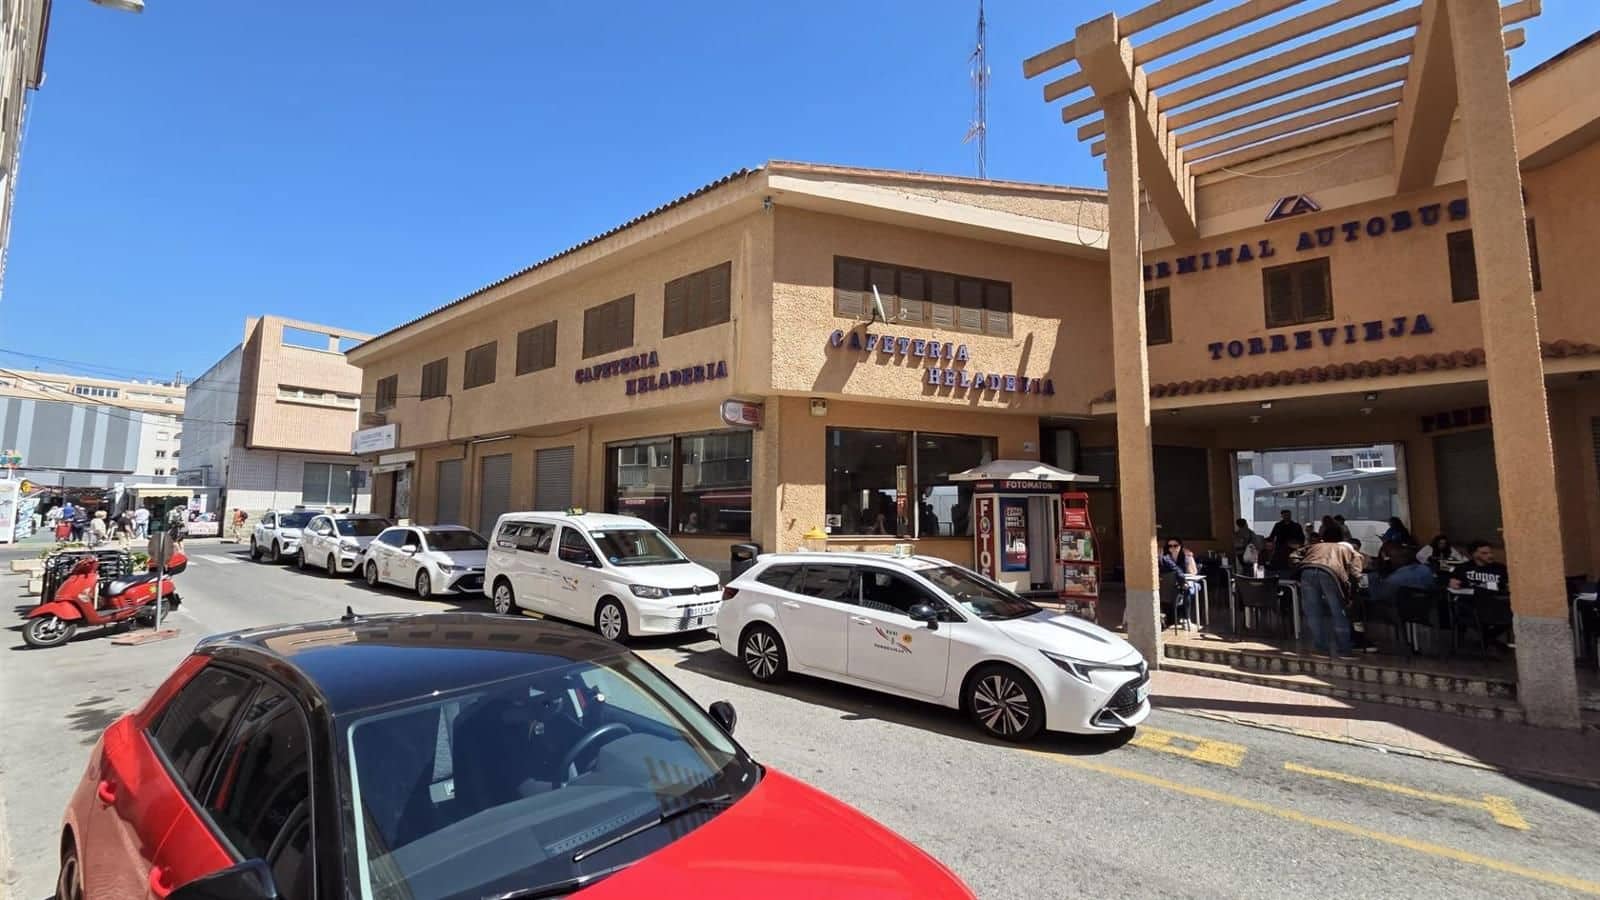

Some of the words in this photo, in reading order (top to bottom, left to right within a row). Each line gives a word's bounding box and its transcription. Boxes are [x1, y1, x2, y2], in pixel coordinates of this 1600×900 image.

[832, 329, 969, 361] CAFETERIA
[1208, 313, 1434, 361] TORREVIEJA
[574, 350, 660, 384] CAFETERIA
[625, 360, 728, 396] HELADERIA
[927, 367, 1055, 396] HELADERIA
[1006, 480, 1053, 490] FOTOMATON
